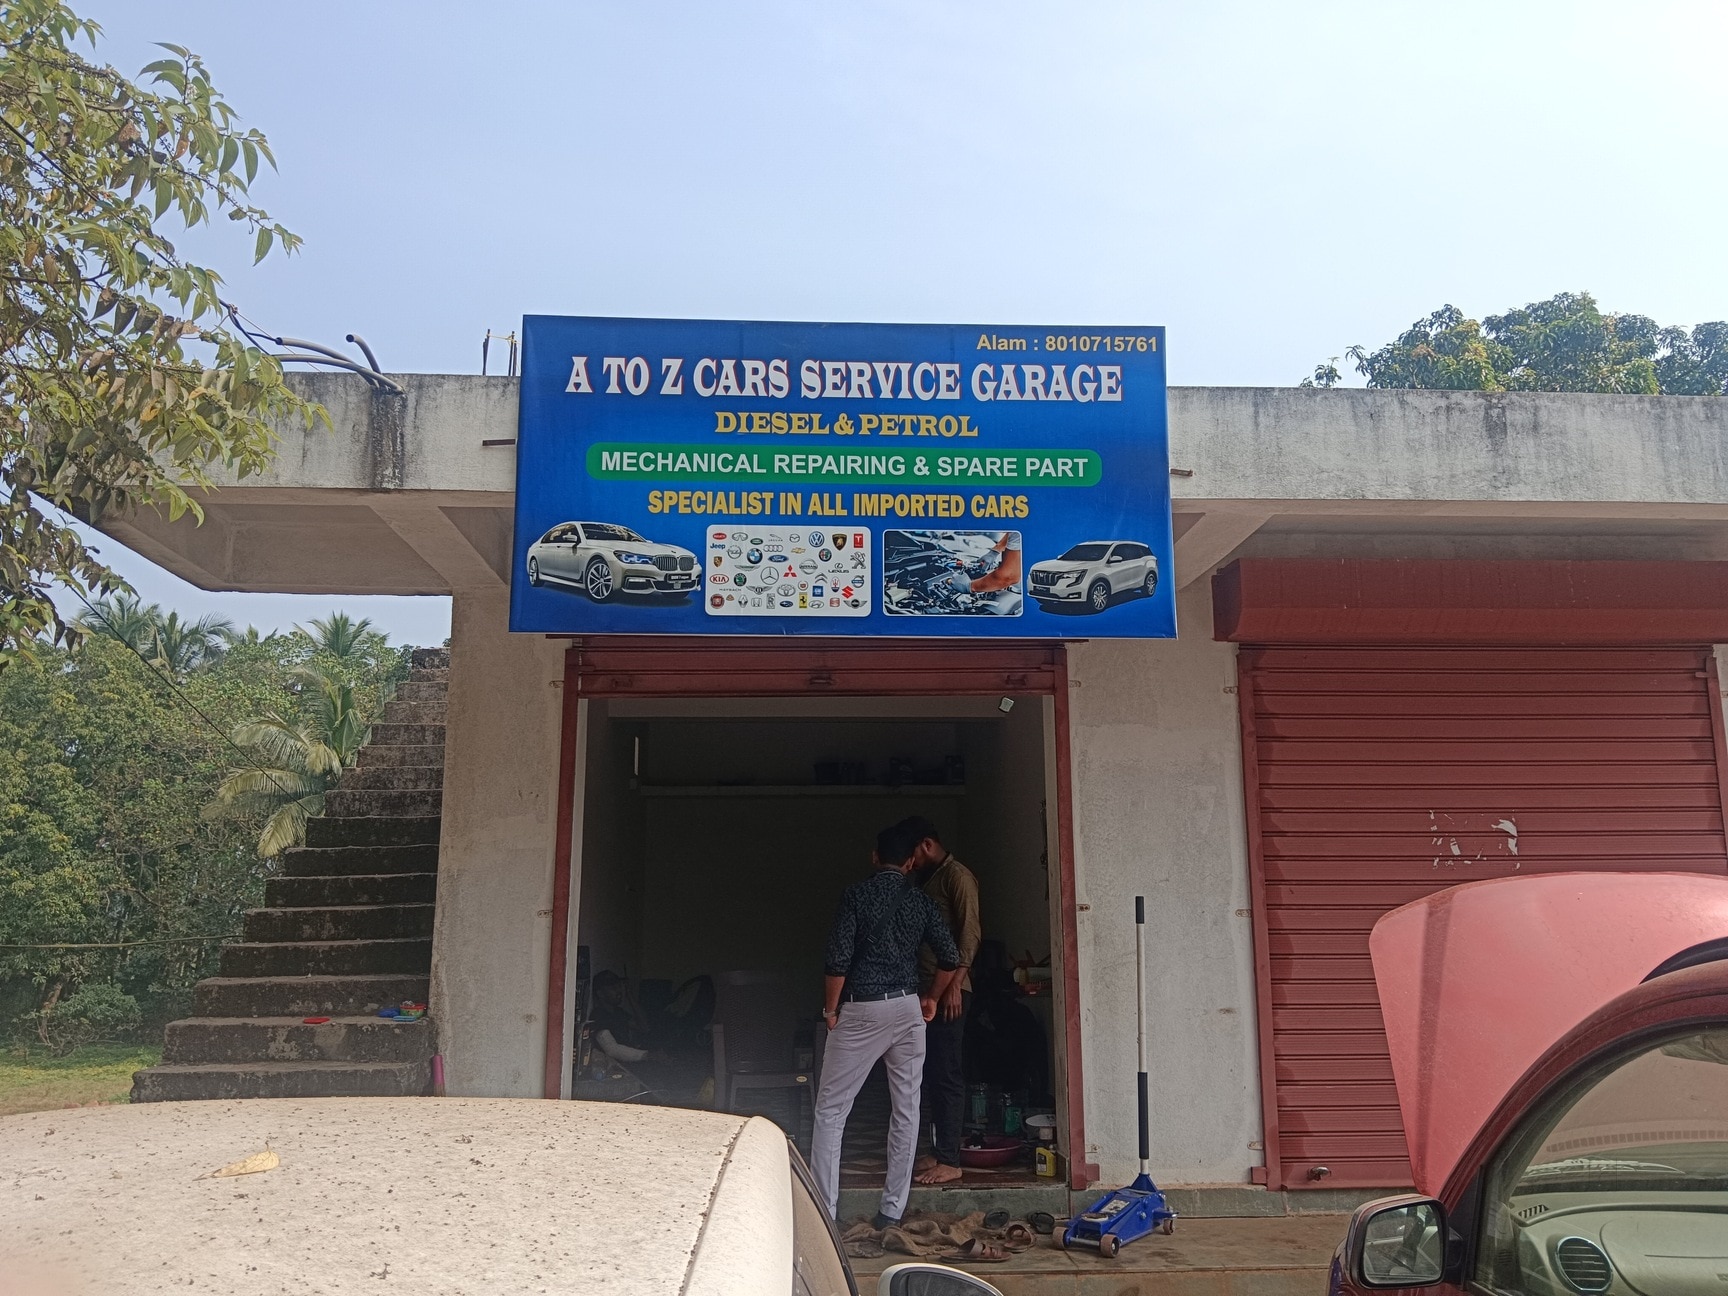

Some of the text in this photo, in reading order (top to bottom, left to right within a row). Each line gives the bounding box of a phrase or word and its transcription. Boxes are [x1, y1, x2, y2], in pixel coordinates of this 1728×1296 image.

[977, 334, 1027, 351] Alam
[1045, 335, 1157, 352] 8010715761
[565, 356, 1122, 403] A TO Z CARS SERVICE GARAGE
[714, 411, 979, 437] DIESEL & PETROL
[601, 451, 1089, 477] MECHANICAL REPAIRING & SPARE PART
[647, 490, 1030, 518] SPECIALIST IN ALL IMPORTED CARS
